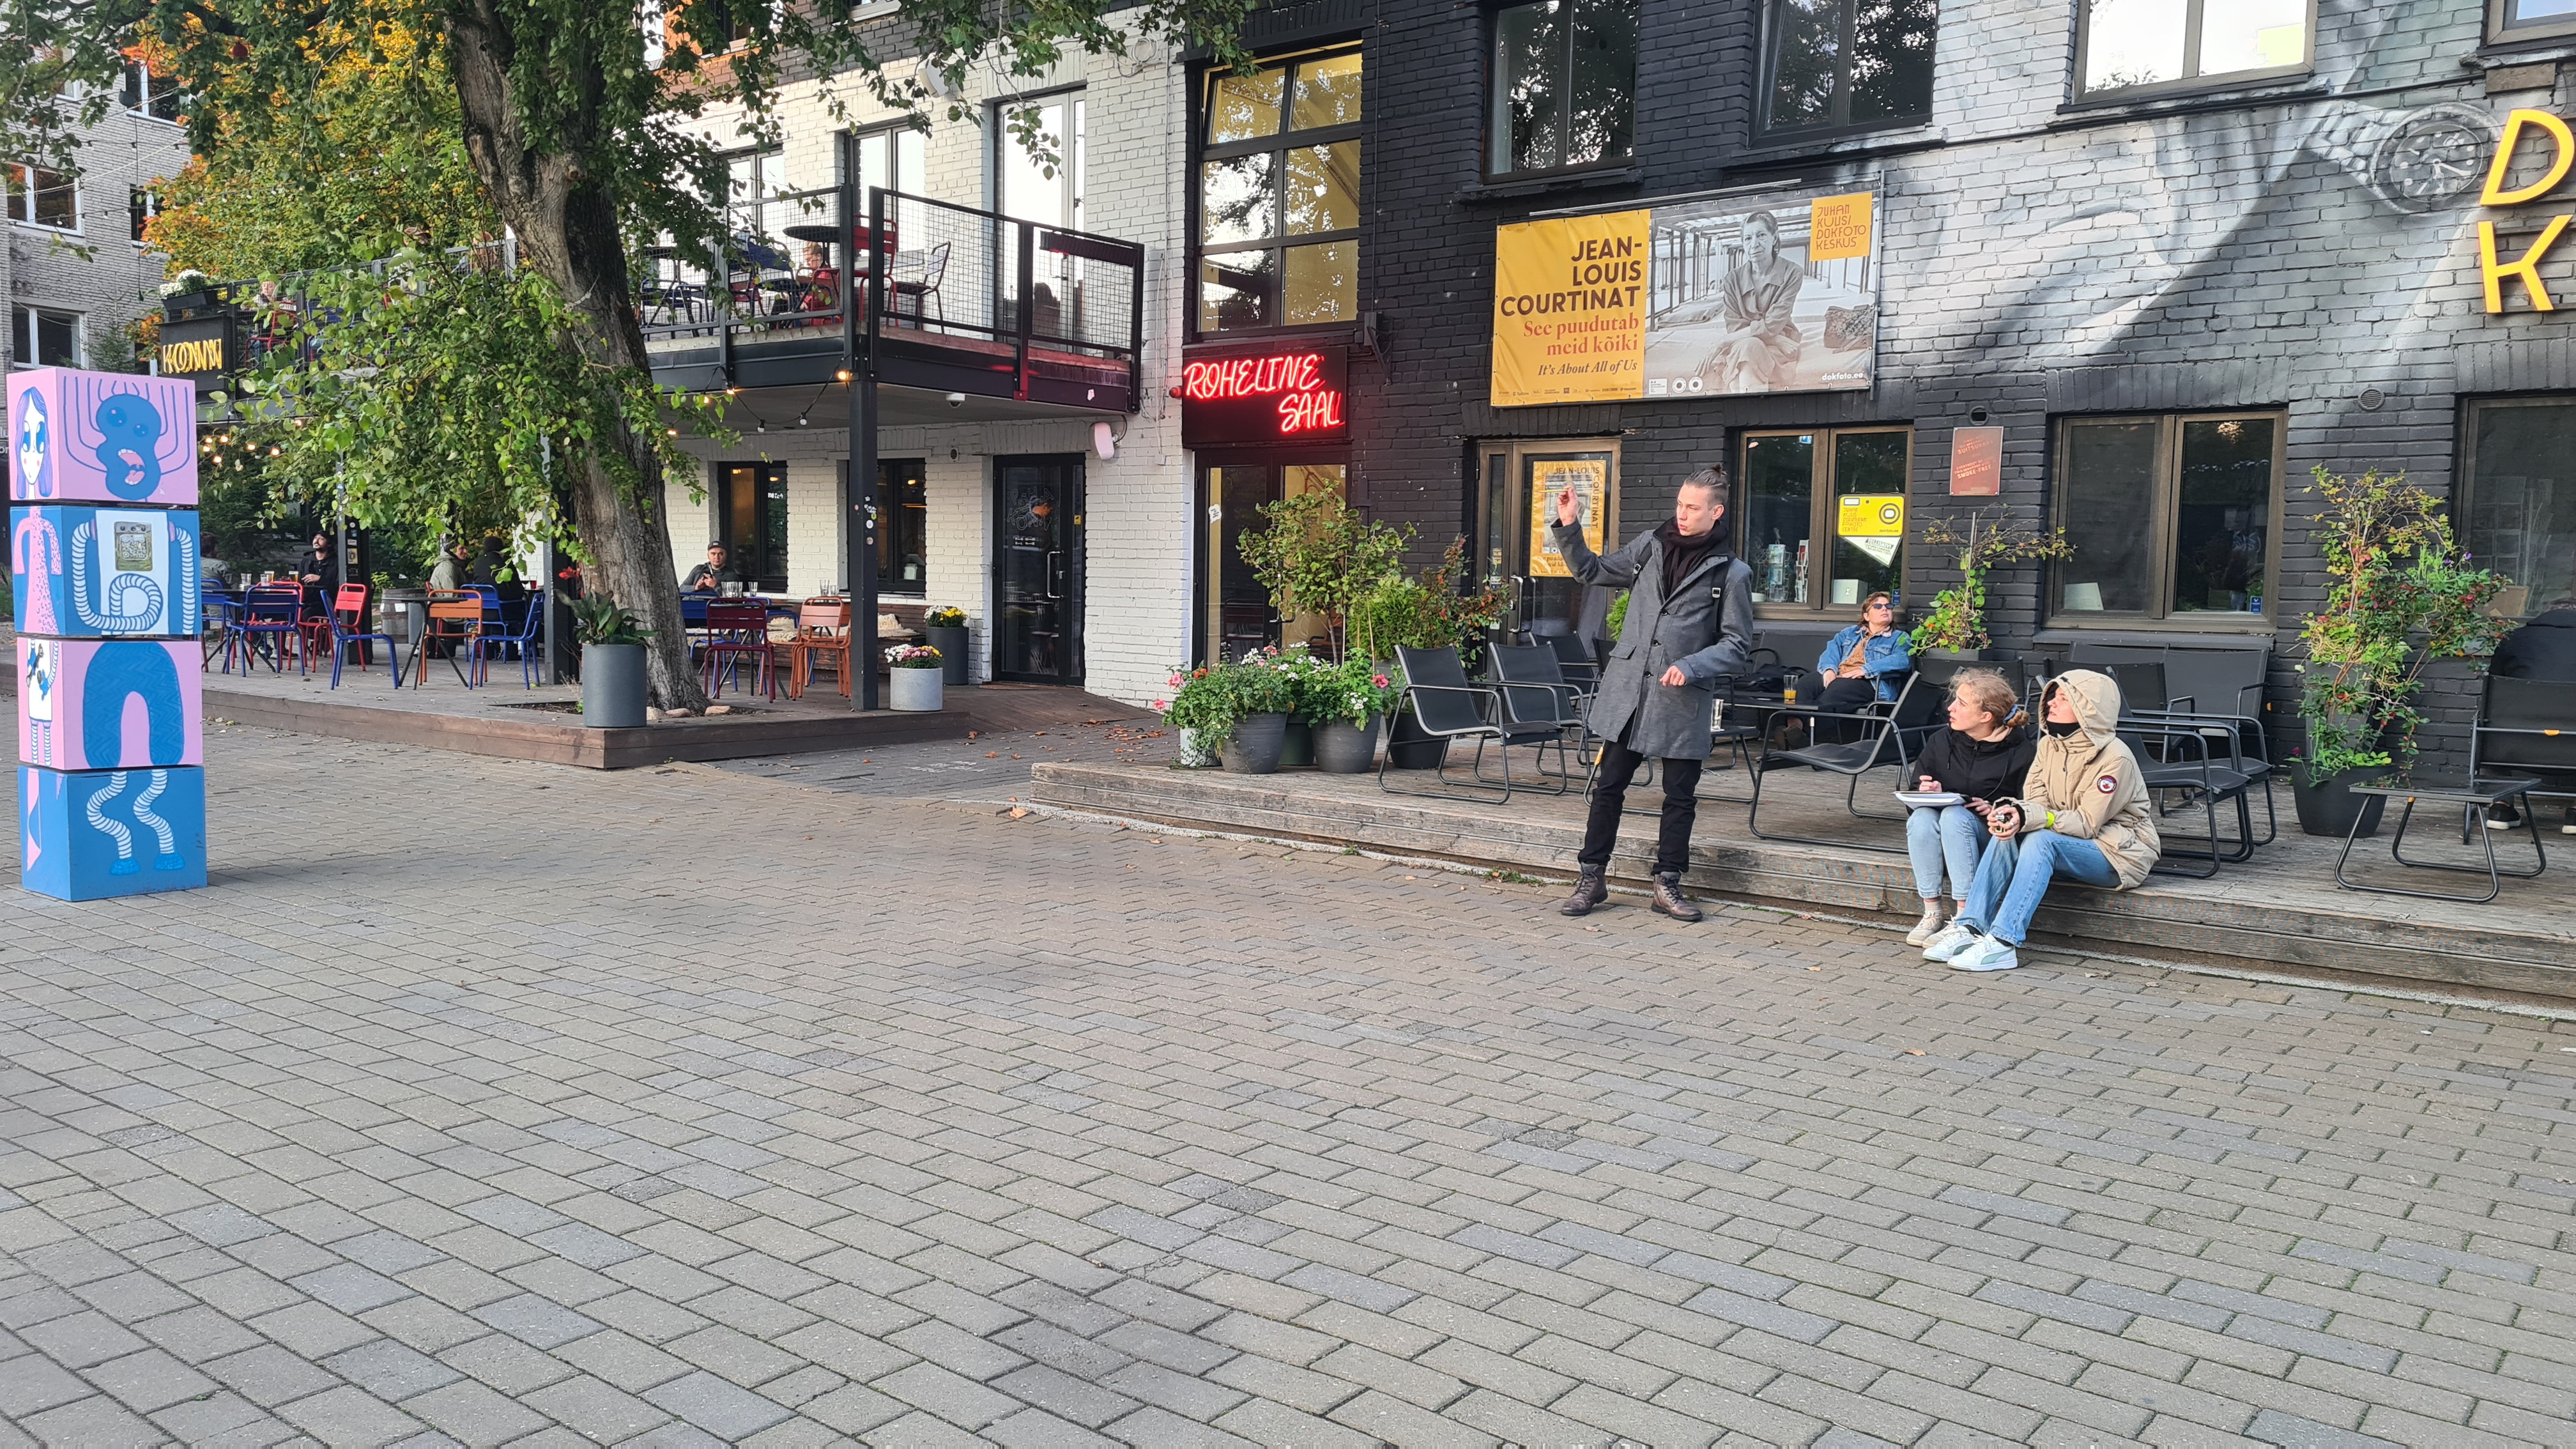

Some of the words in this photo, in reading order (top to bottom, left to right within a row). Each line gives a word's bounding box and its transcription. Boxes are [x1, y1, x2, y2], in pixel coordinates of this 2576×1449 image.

[1817, 204, 1850, 217] JUHAN
[1816, 225, 1866, 240] DOKFOTO
[1816, 237, 1857, 250] KESKUS
[1571, 235, 1643, 262] JEAN-
[1572, 260, 1641, 286] LOUIS
[1501, 286, 1641, 316] COURTINAT
[1524, 320, 1552, 337] See
[1557, 312, 1639, 340] puudutab
[162, 338, 222, 374] KONN
[1547, 338, 1588, 356] meid
[1593, 334, 1637, 353] kõiki
[1183, 354, 1322, 399] ROHELINE
[1538, 364, 1556, 376] It's
[1557, 363, 1590, 375] About
[1591, 361, 1608, 372] All
[1610, 360, 1623, 375] of
[1624, 359, 1637, 371] Us
[1821, 372, 1864, 381] dokfoto.ee
[1278, 390, 1341, 433] SAAL
[1591, 475, 1600, 528] COURTINAT
